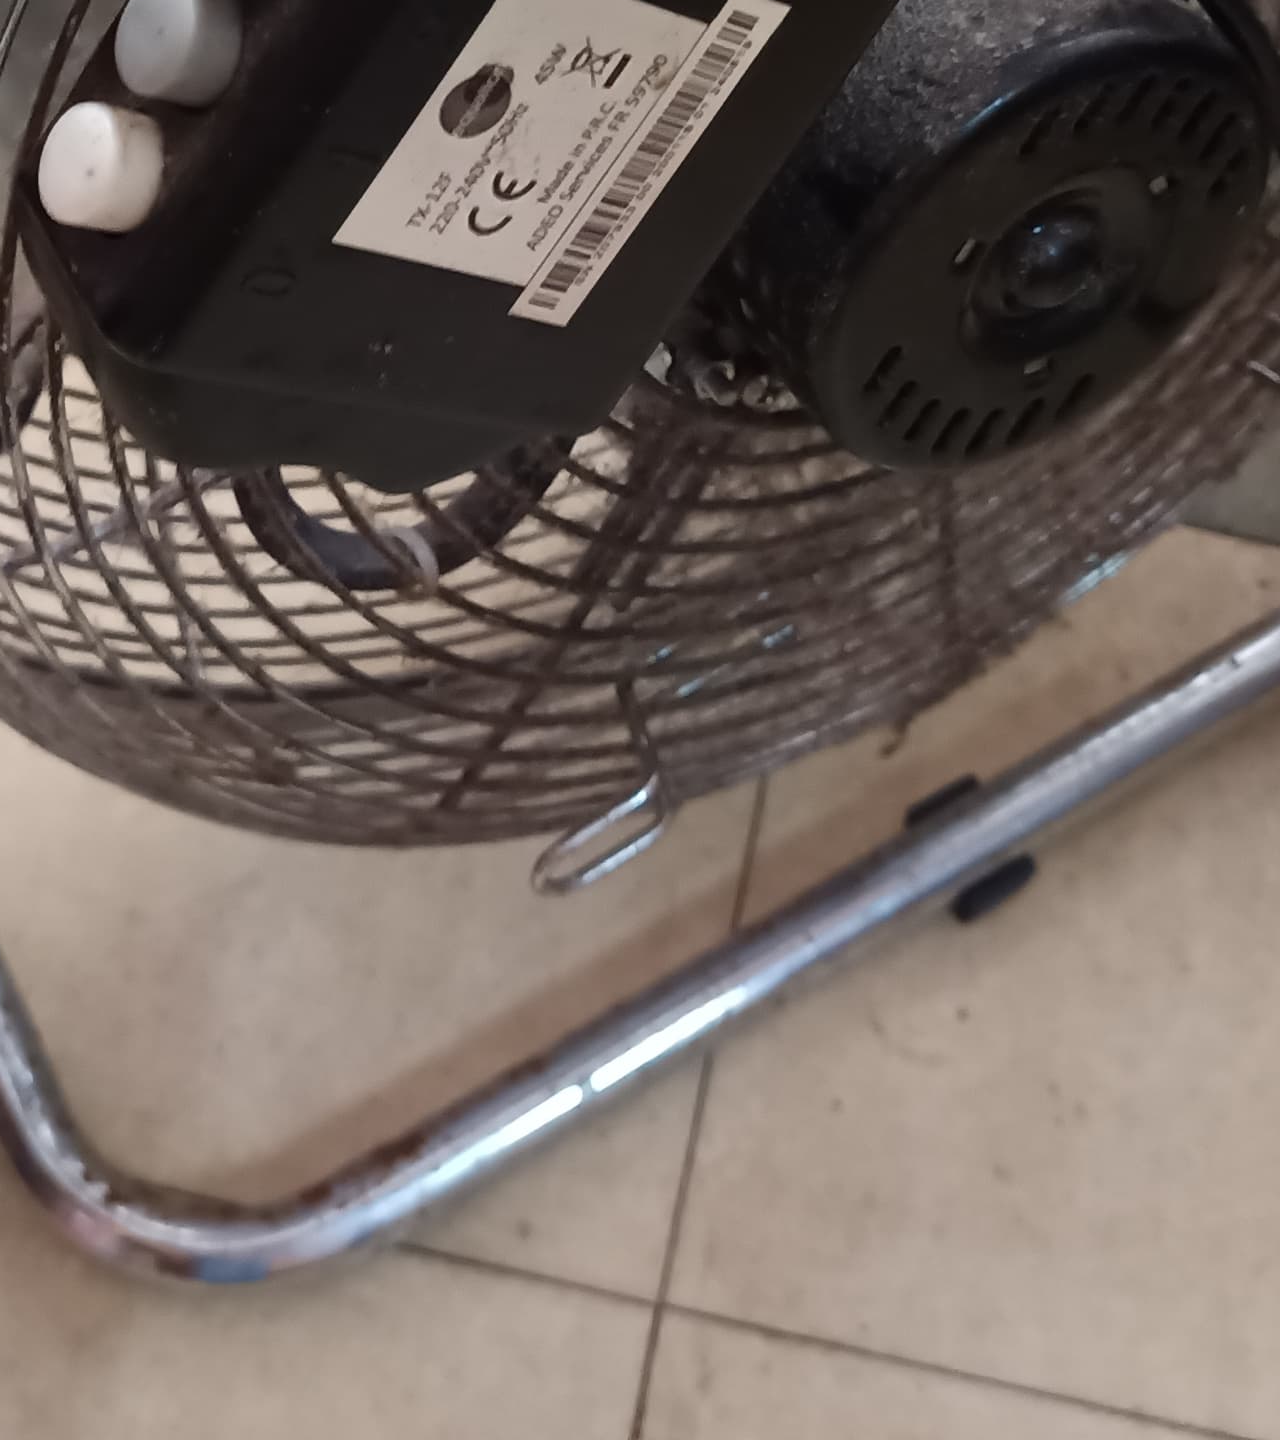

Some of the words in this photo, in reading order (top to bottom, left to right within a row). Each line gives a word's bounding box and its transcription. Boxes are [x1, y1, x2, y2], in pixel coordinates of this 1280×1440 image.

[535, 42, 567, 85] 45W
[526, 204, 563, 251] ADEO
[559, 135, 613, 202] Services
[607, 110, 631, 133] FR
[623, 53, 669, 108] 59790
[537, 161, 574, 203] Made
[570, 143, 587, 159] in
